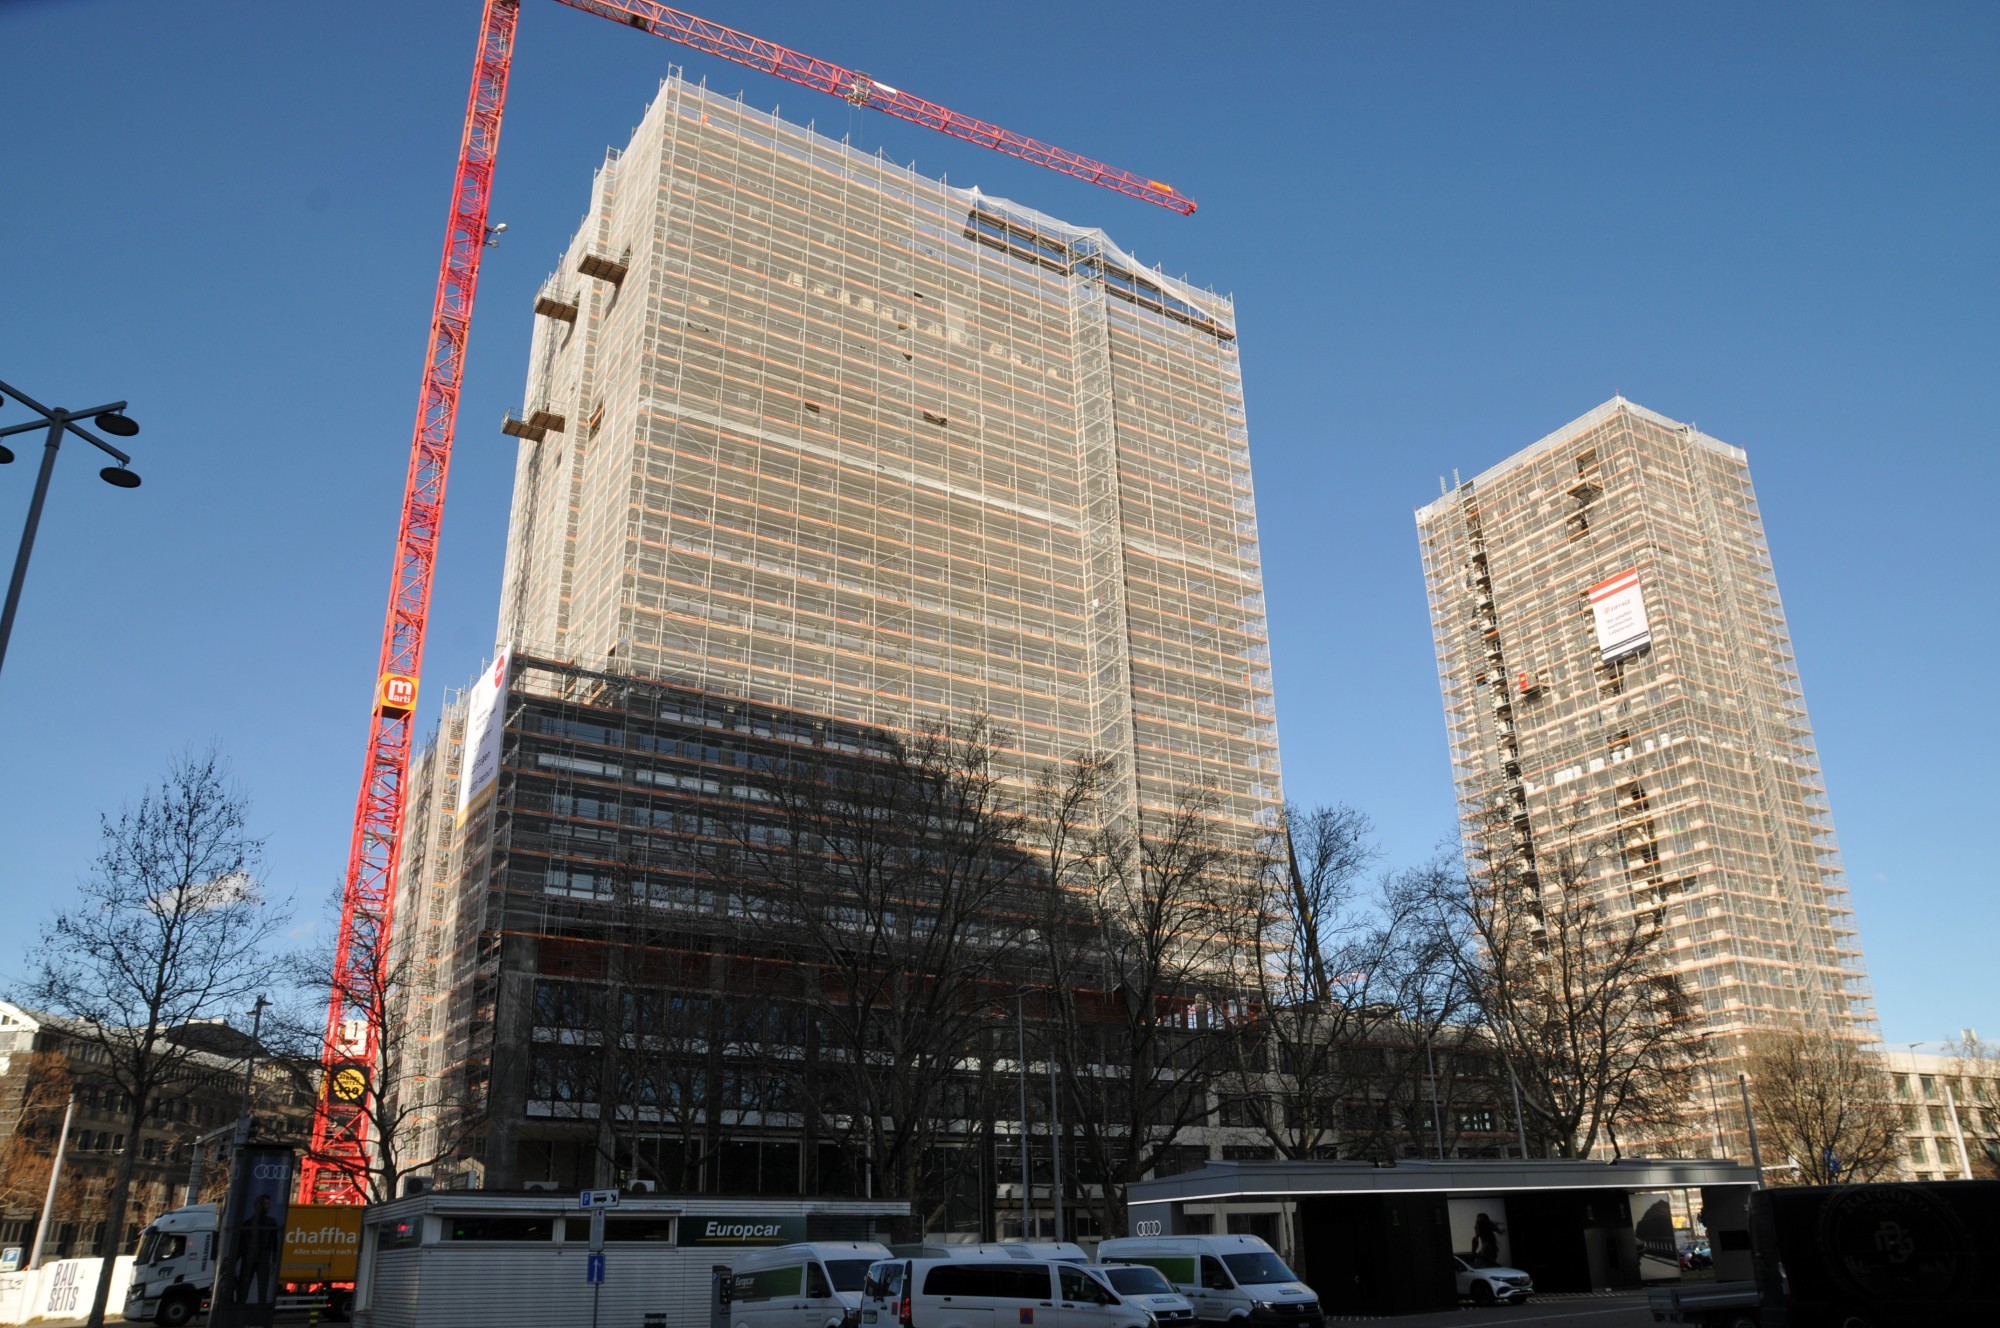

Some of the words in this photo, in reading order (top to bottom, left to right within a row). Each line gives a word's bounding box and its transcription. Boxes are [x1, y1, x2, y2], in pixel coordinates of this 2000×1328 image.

[705, 1221, 782, 1242] Europcar
[53, 1262, 78, 1287] BAU
[735, 1276, 756, 1289] Europcar
[47, 1286, 79, 1312] SEITS
